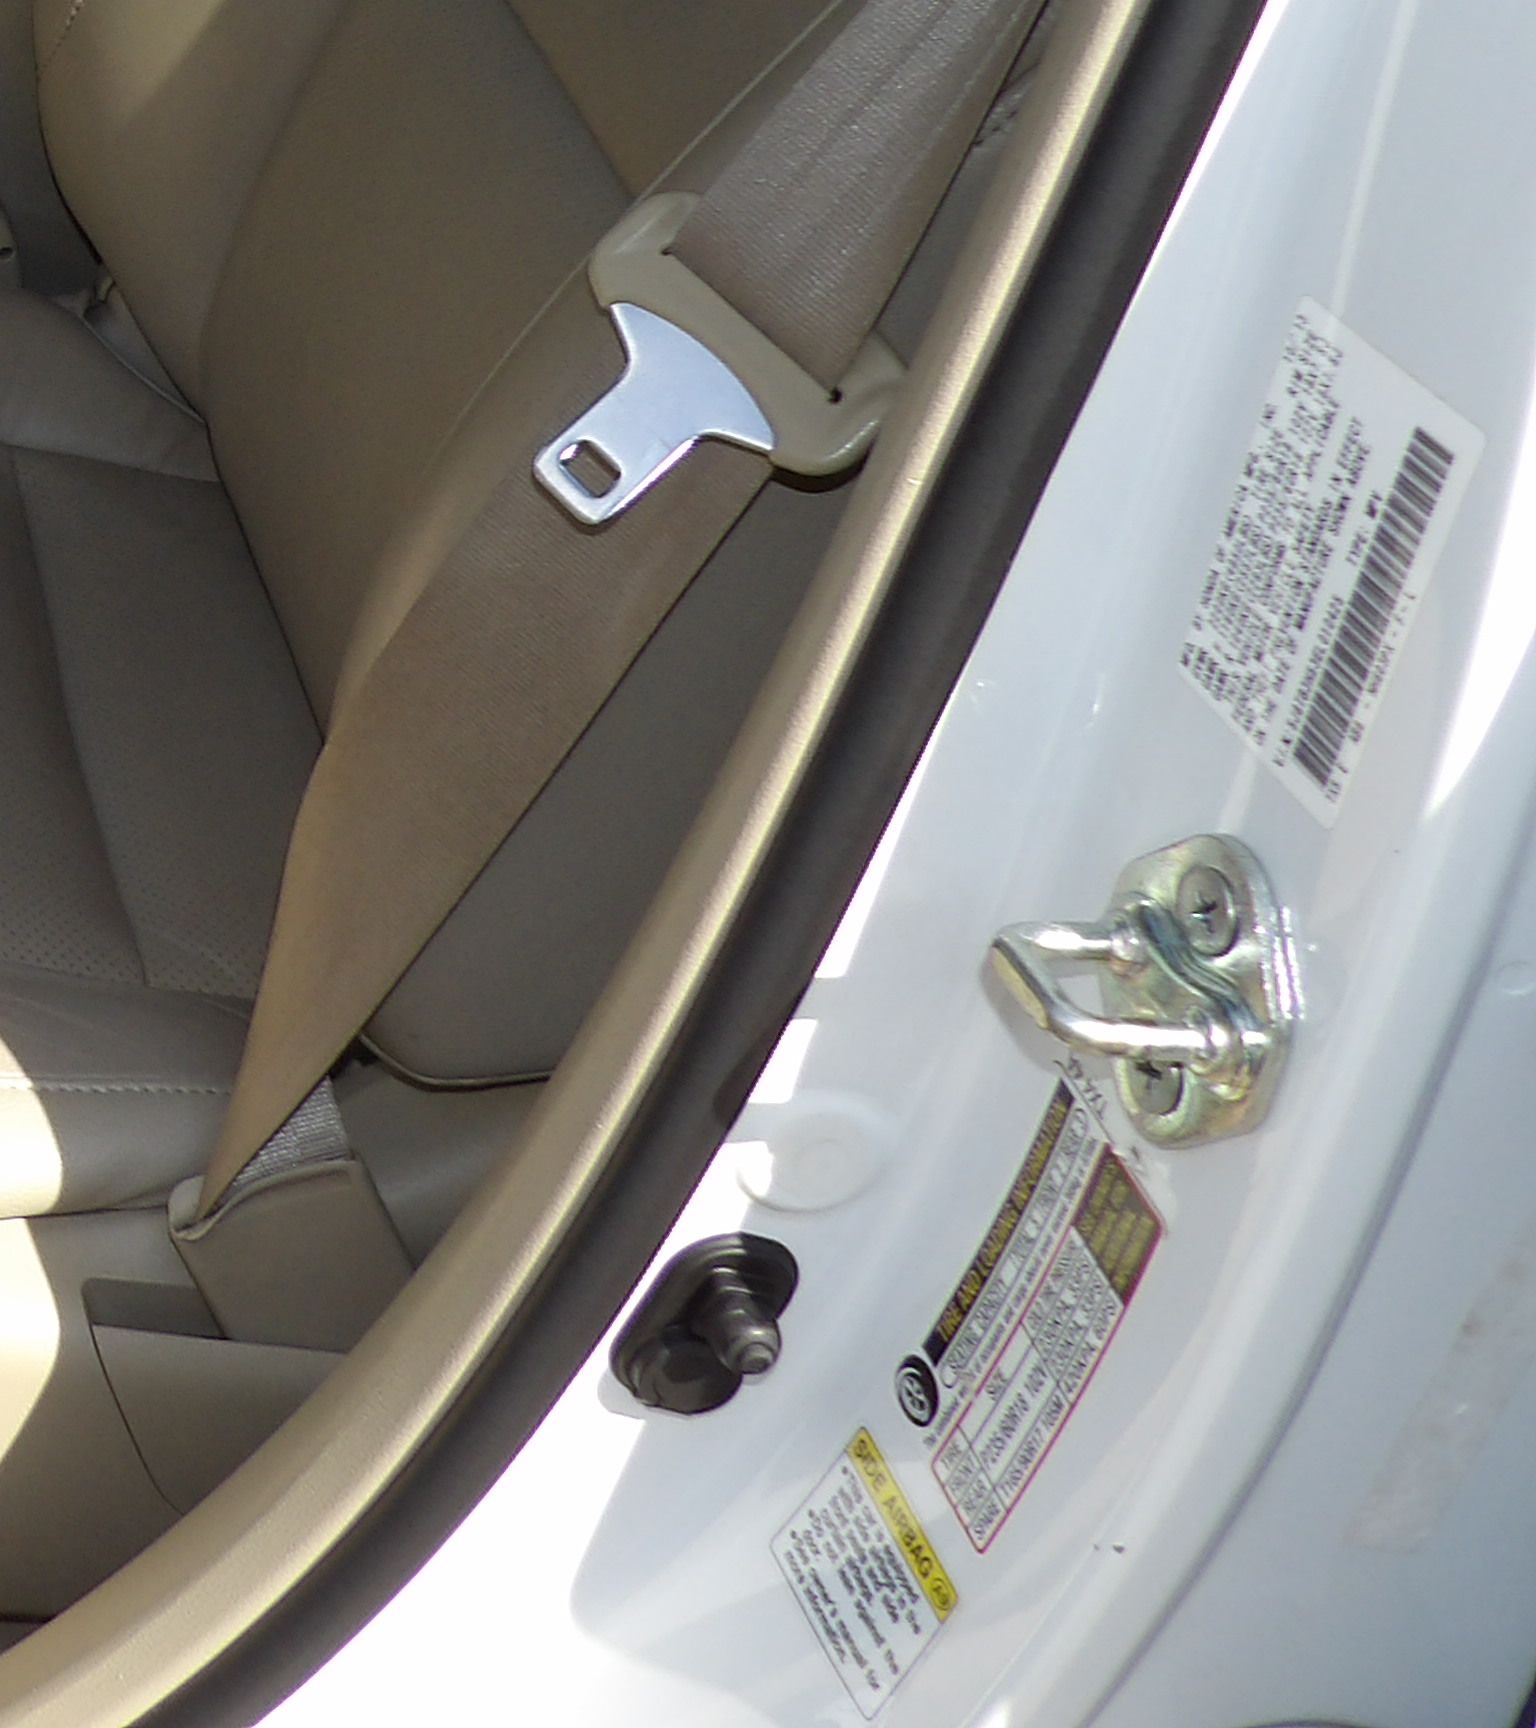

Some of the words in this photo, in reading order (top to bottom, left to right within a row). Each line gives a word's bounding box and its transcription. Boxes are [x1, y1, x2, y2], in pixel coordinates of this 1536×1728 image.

[936, 1297, 963, 1345] TIRE
[955, 1263, 983, 1313] AND
[974, 1197, 1020, 1279] LOADING
[1009, 1095, 1067, 1213] INFORMATION
[851, 1433, 888, 1495] SIDE
[881, 1489, 936, 1582] AIRBAG
